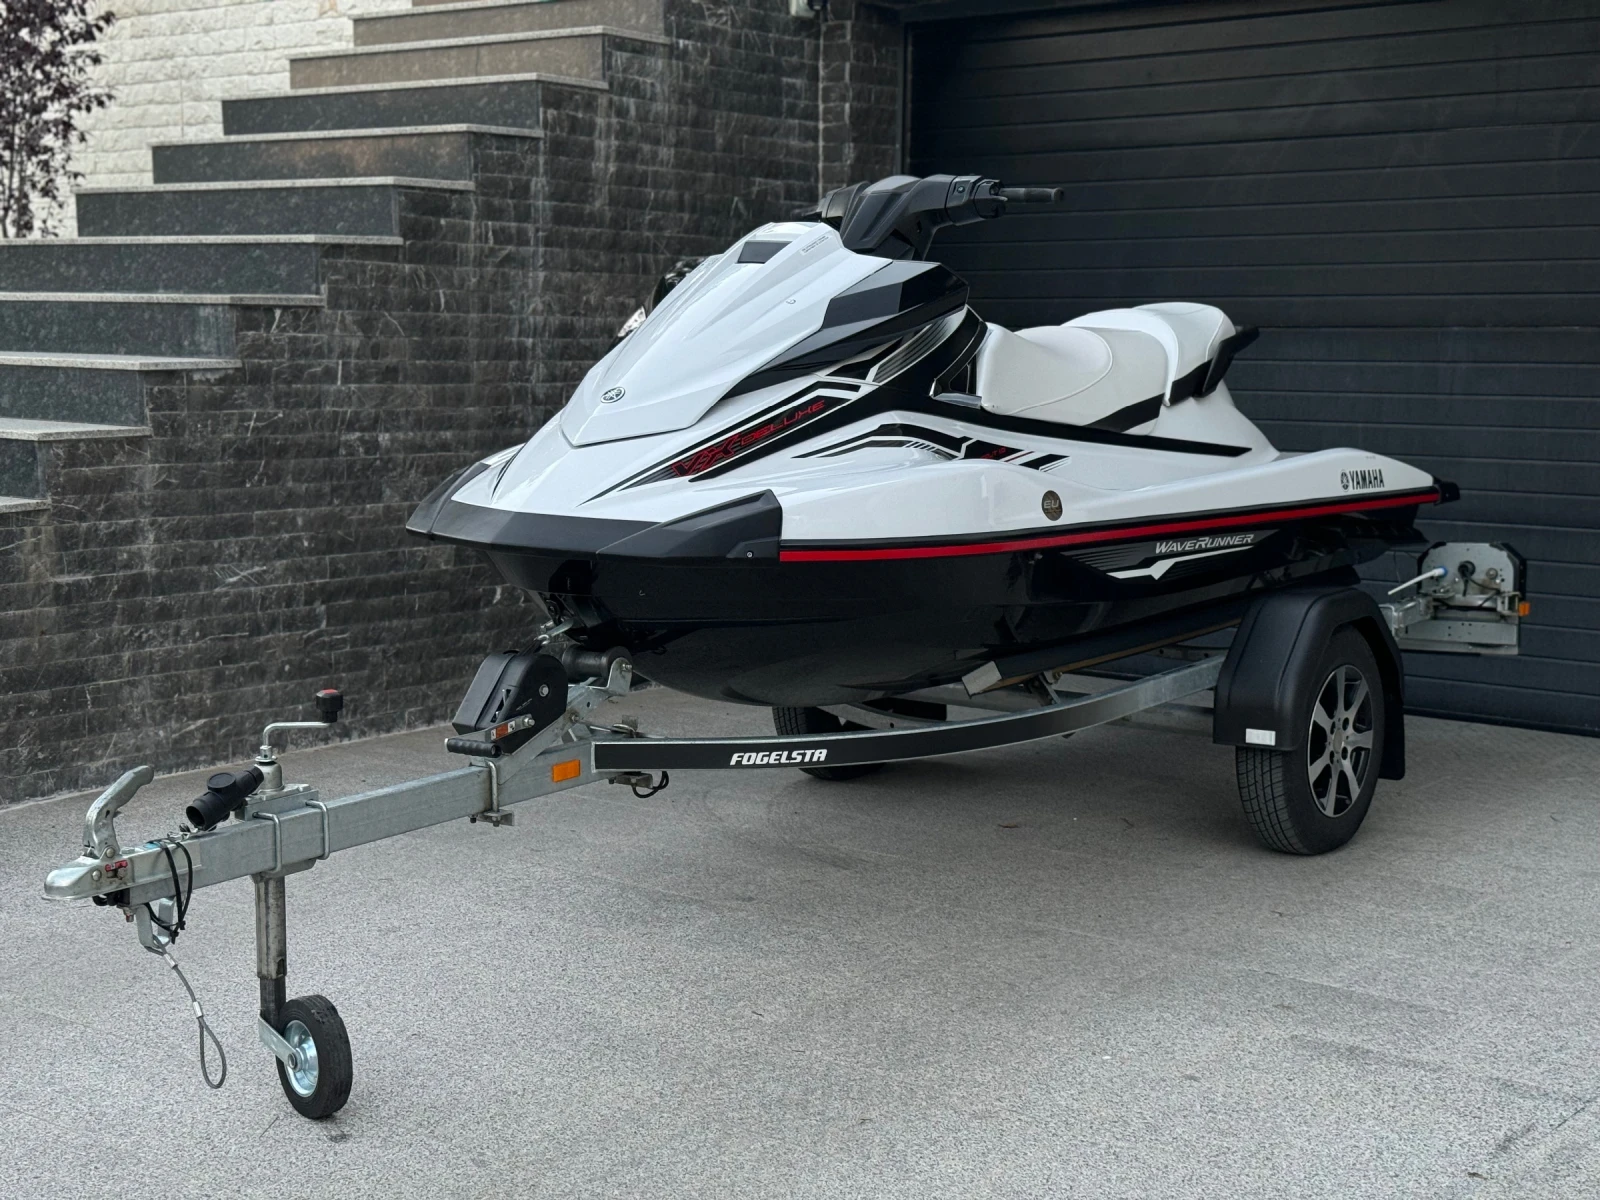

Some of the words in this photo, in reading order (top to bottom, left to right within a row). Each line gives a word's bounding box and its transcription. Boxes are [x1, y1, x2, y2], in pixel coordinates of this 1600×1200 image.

[671, 432, 741, 477] VX
[741, 400, 825, 446] DELUXE
[1349, 468, 1385, 490] YAMAHA
[1043, 499, 1060, 509] EU
[1155, 534, 1254, 554] WAVERUNNER
[729, 748, 828, 766] FOGELSTA
